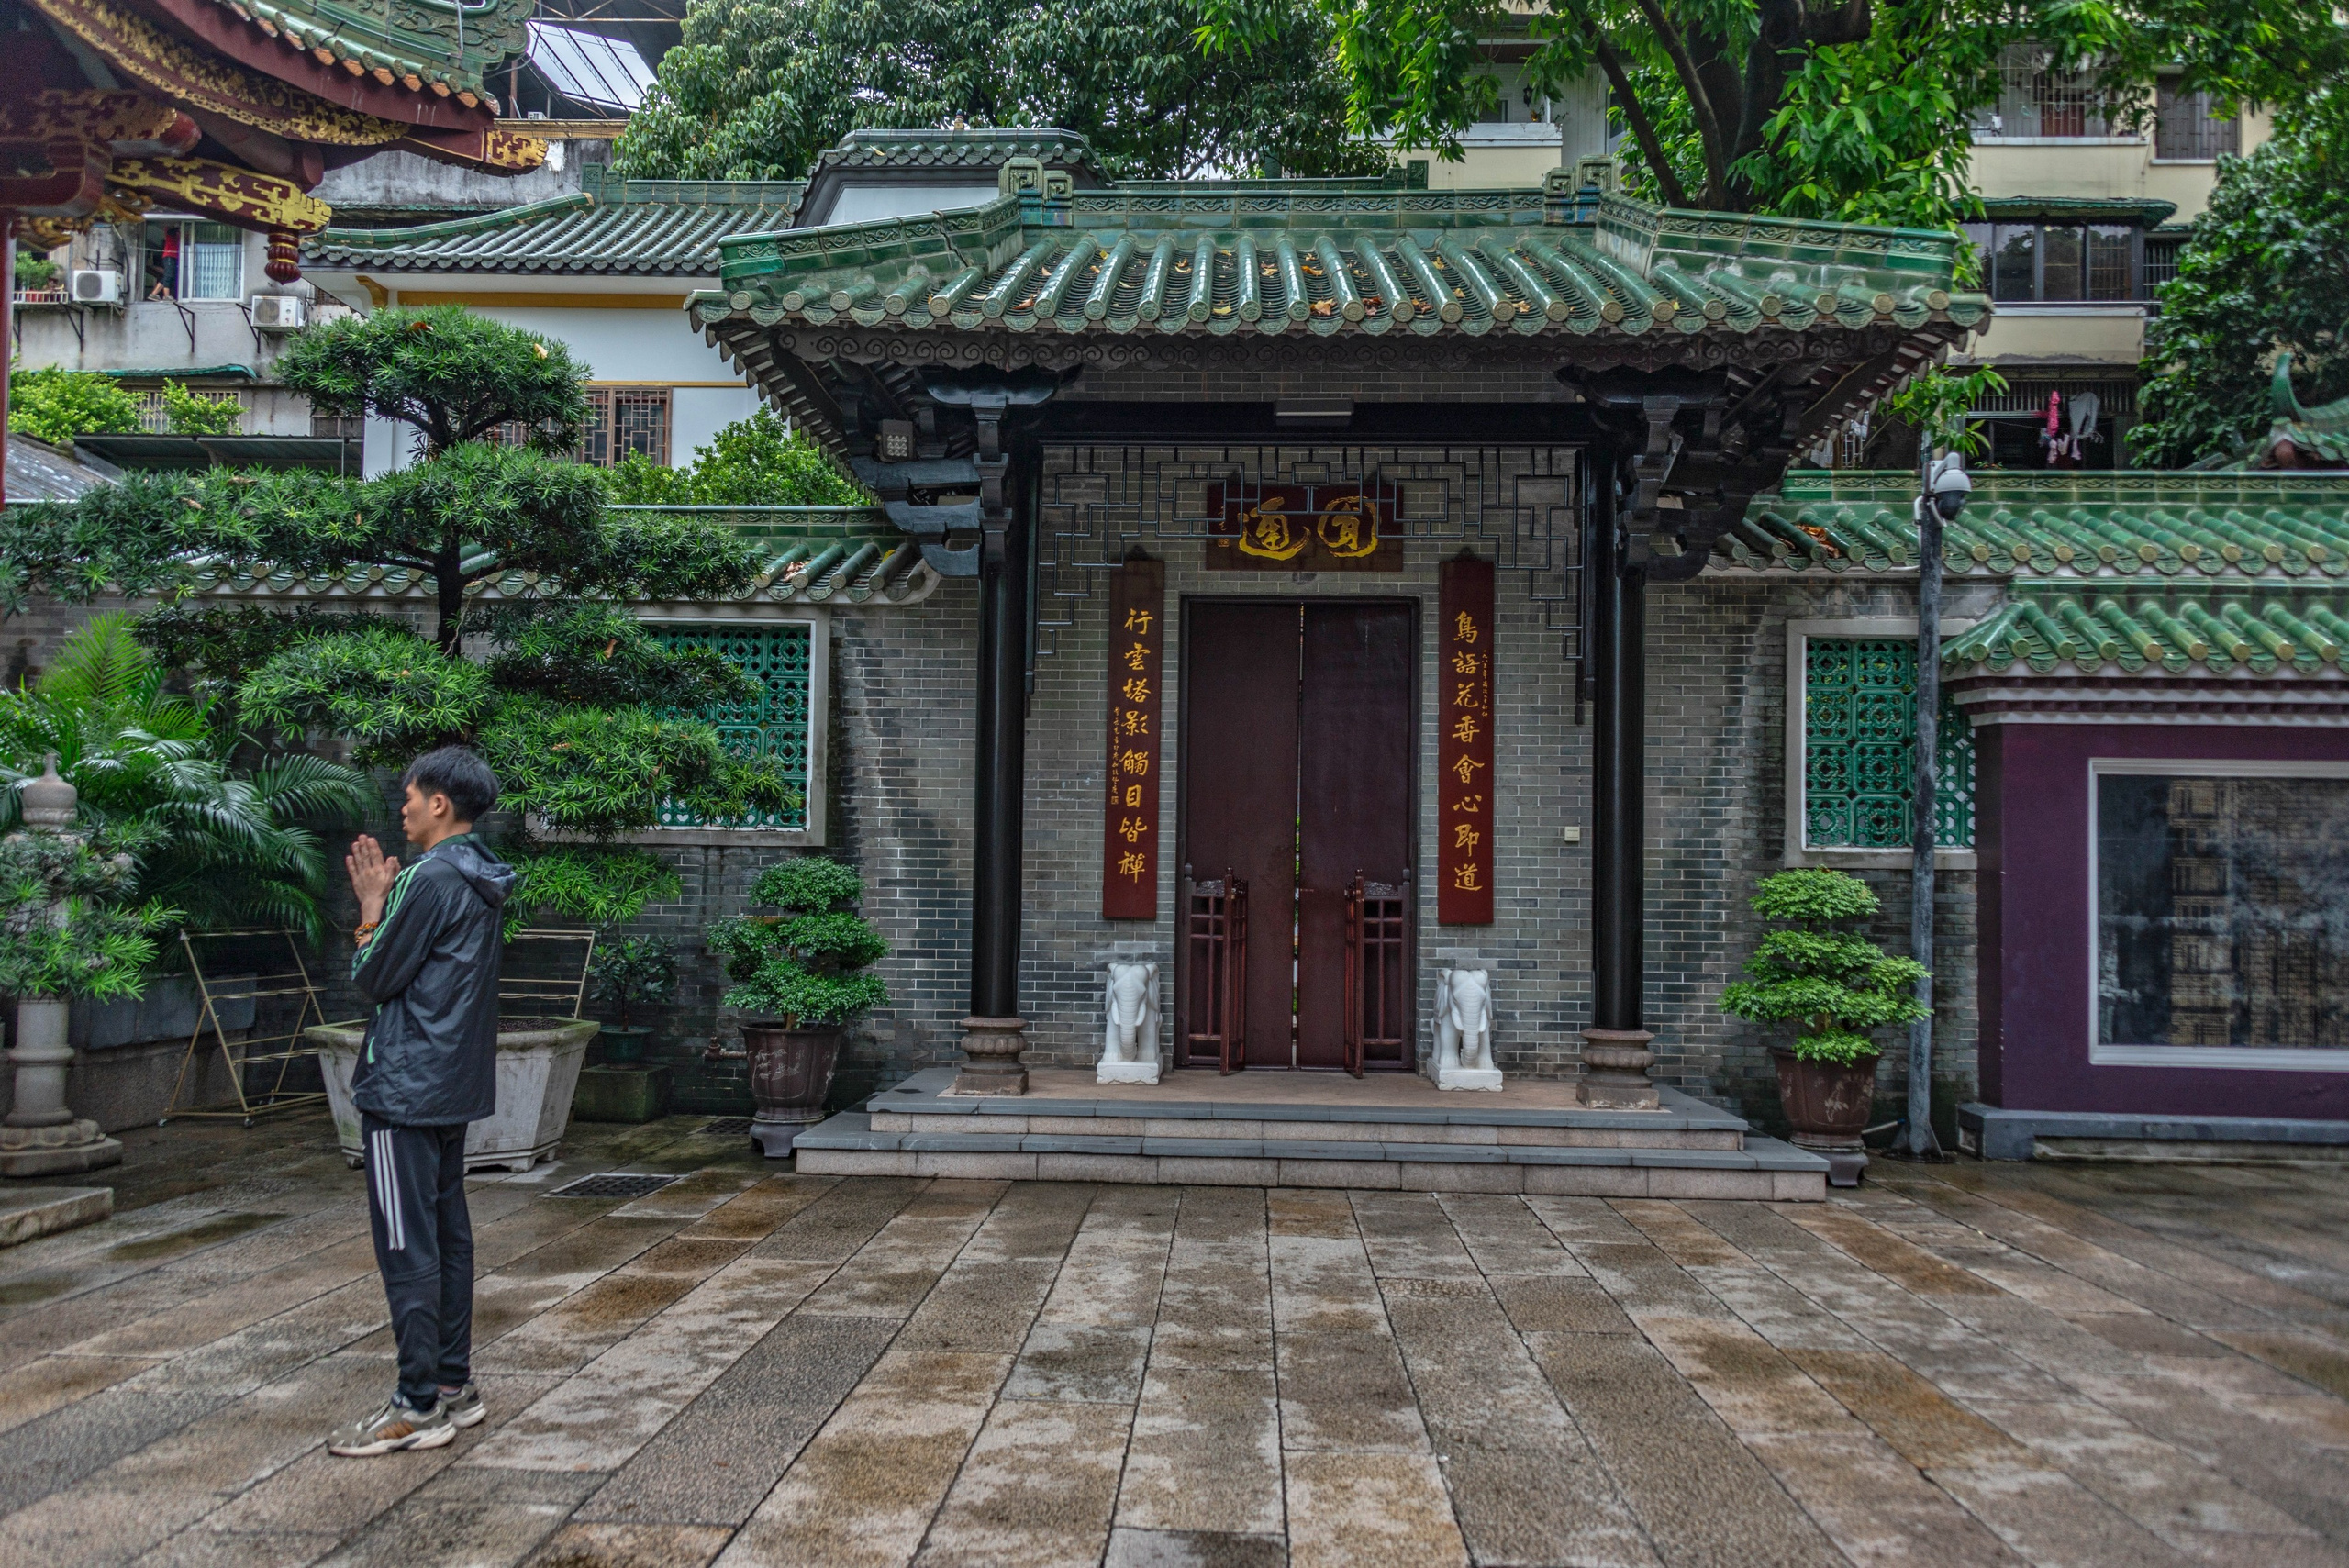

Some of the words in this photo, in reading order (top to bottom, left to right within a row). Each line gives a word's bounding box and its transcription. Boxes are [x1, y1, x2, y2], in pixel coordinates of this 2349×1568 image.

[1118, 607, 1153, 884] 行雲塔影觸目皆禪
[1452, 610, 1485, 892] 鳥語花香會心即道
